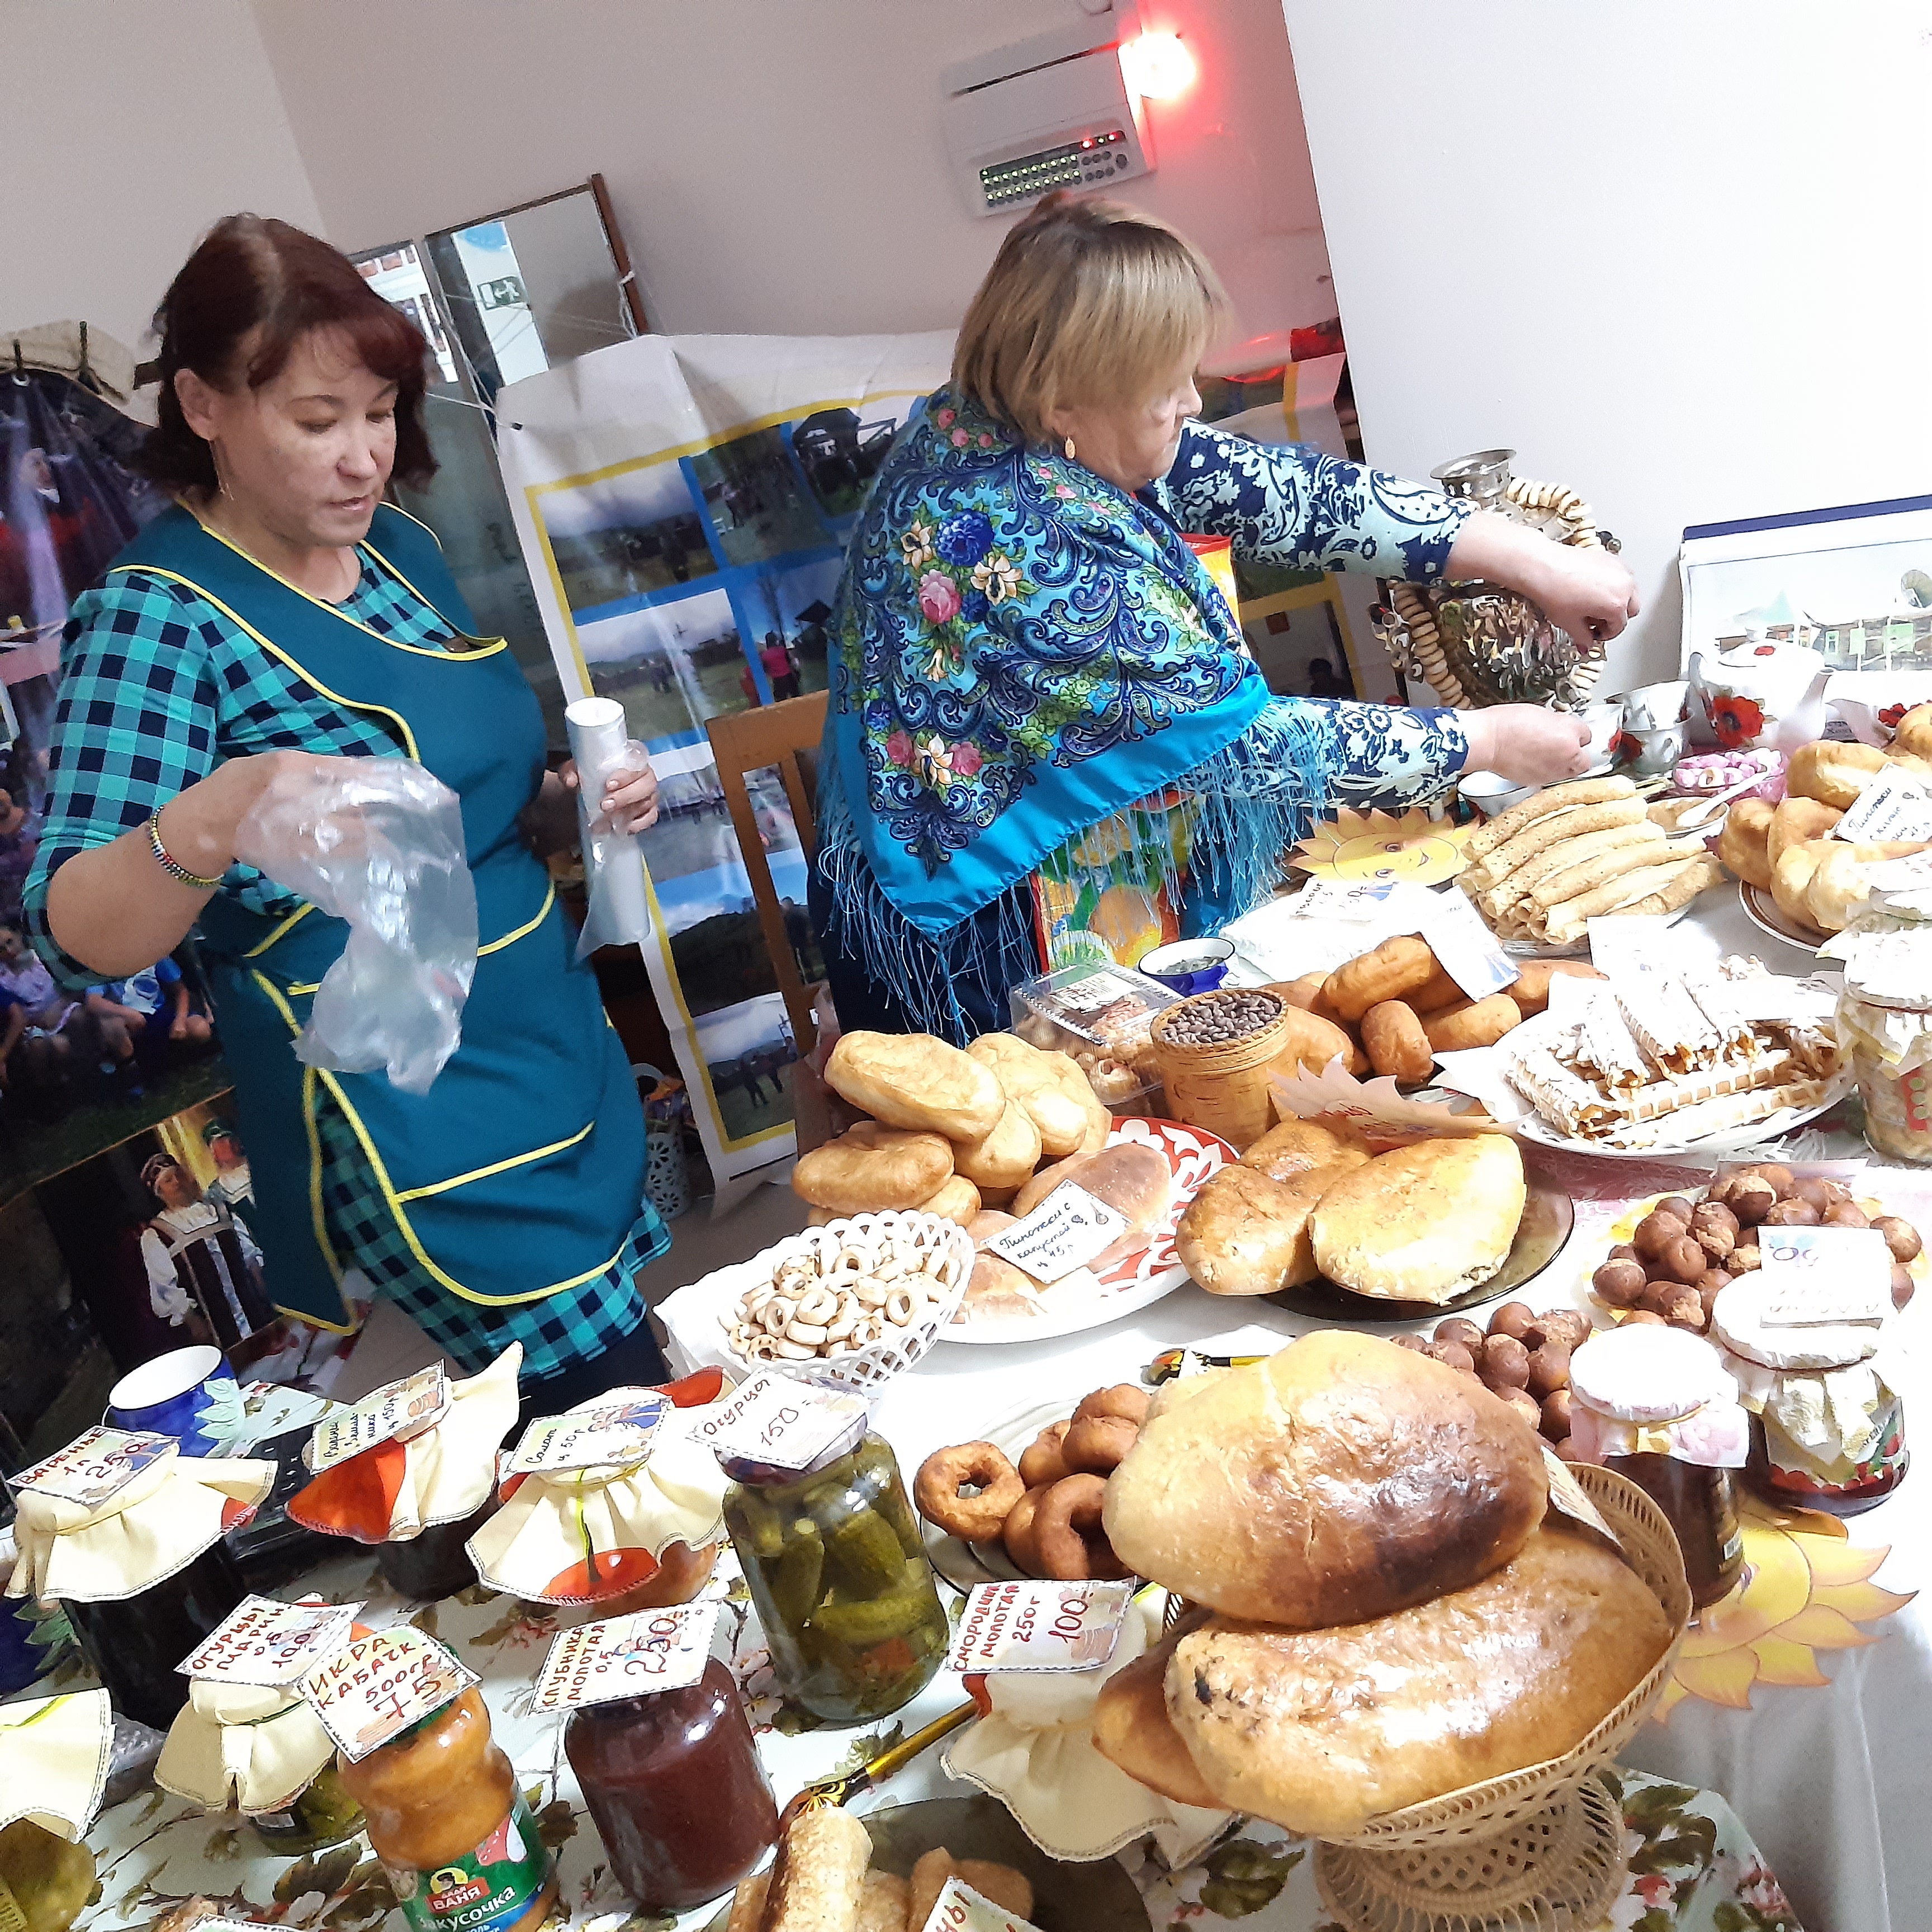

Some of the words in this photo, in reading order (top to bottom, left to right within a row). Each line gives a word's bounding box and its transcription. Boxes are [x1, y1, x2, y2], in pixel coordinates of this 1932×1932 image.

[1000, 1210, 1062, 1249] Пирожки
[1017, 1222, 1071, 1258] капустой
[18, 1429, 108, 1484] ВАРЕНЬЕ
[525, 1428, 557, 1464] Салат
[192, 1607, 266, 1670] ОГУРЦЫ
[980, 1584, 1020, 1658] МОЛОТАЯ
[309, 1638, 391, 1695] ИКРА
[542, 1626, 587, 1707] КЛУБНИКА
[567, 1625, 606, 1701] МОЛОТАЯ
[432, 1886, 482, 1911] ВАНЯ
